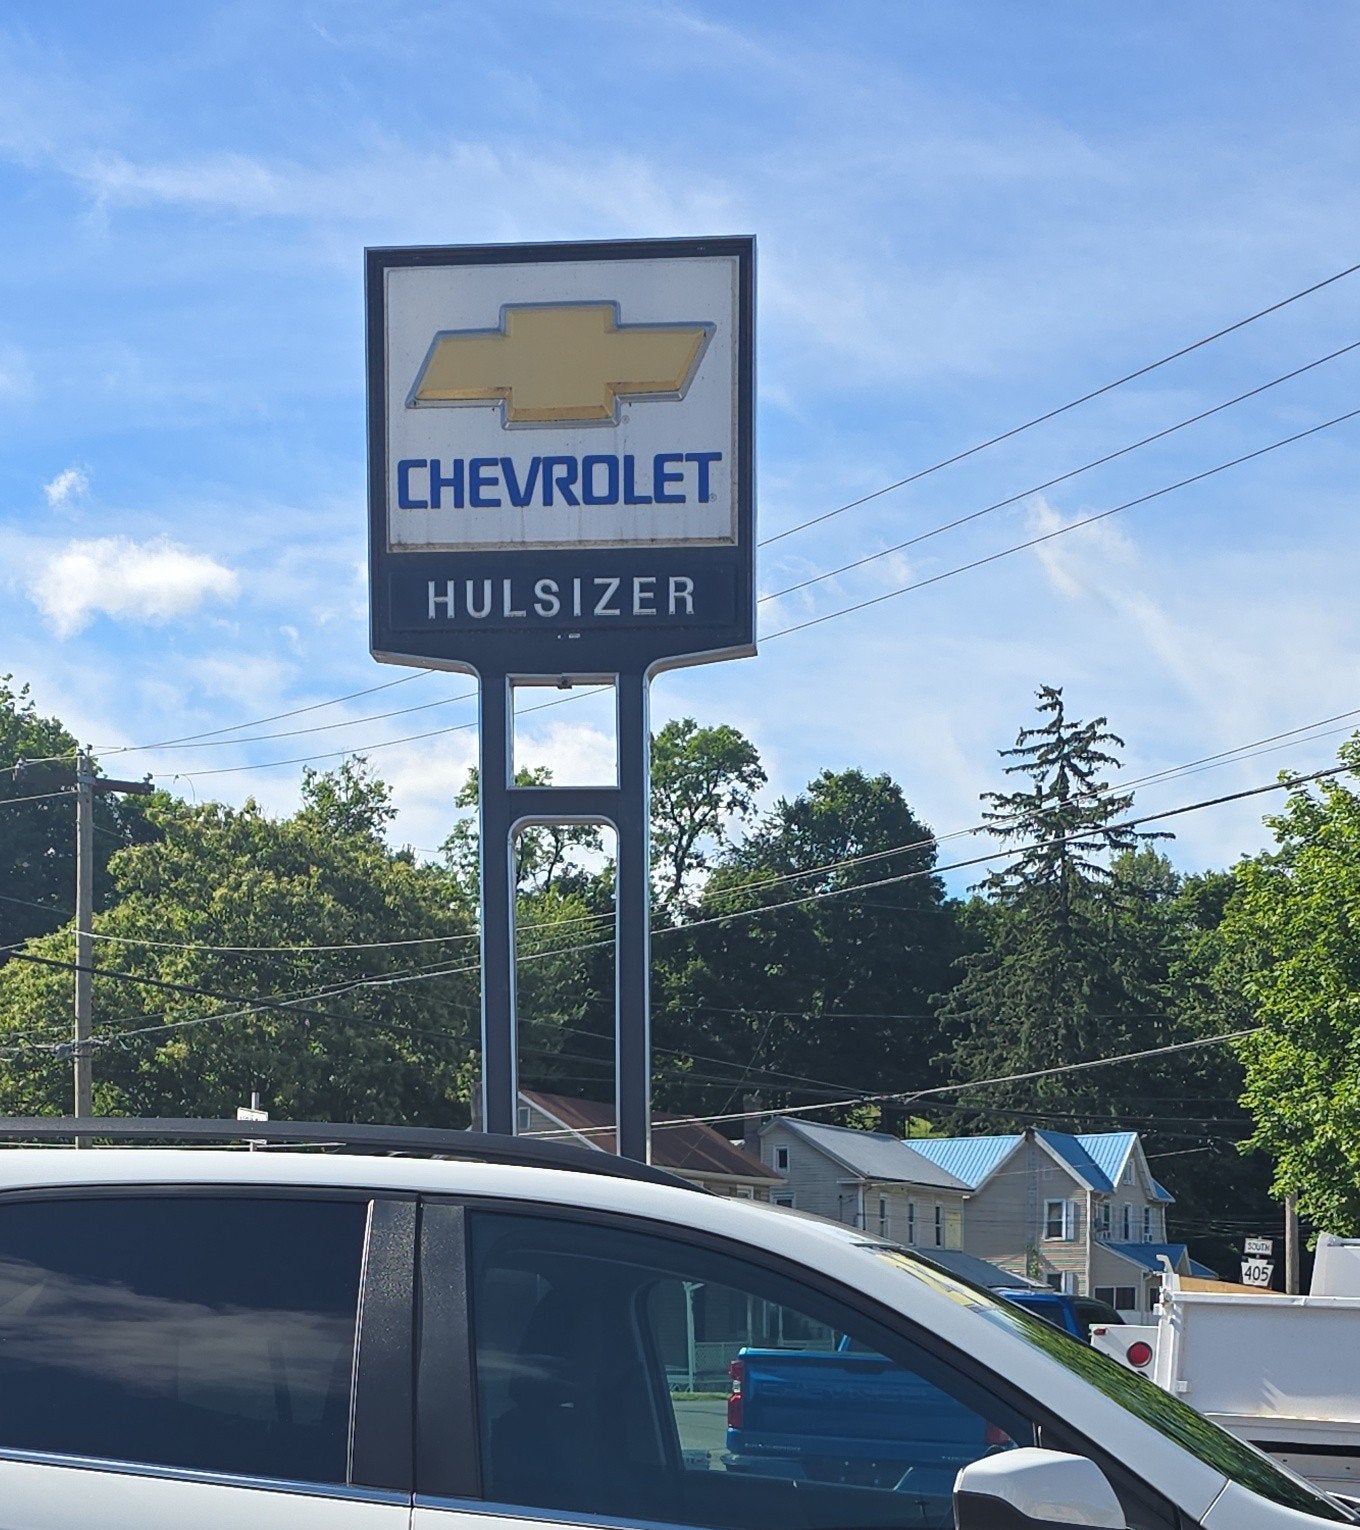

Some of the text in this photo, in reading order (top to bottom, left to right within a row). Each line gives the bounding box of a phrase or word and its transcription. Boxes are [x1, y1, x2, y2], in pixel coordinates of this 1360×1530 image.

[397, 452, 723, 509] CHEVROLET
[427, 576, 695, 619] HULSIZER
[1247, 1241, 1270, 1251] SOUTH
[1244, 1265, 1269, 1281] 405
